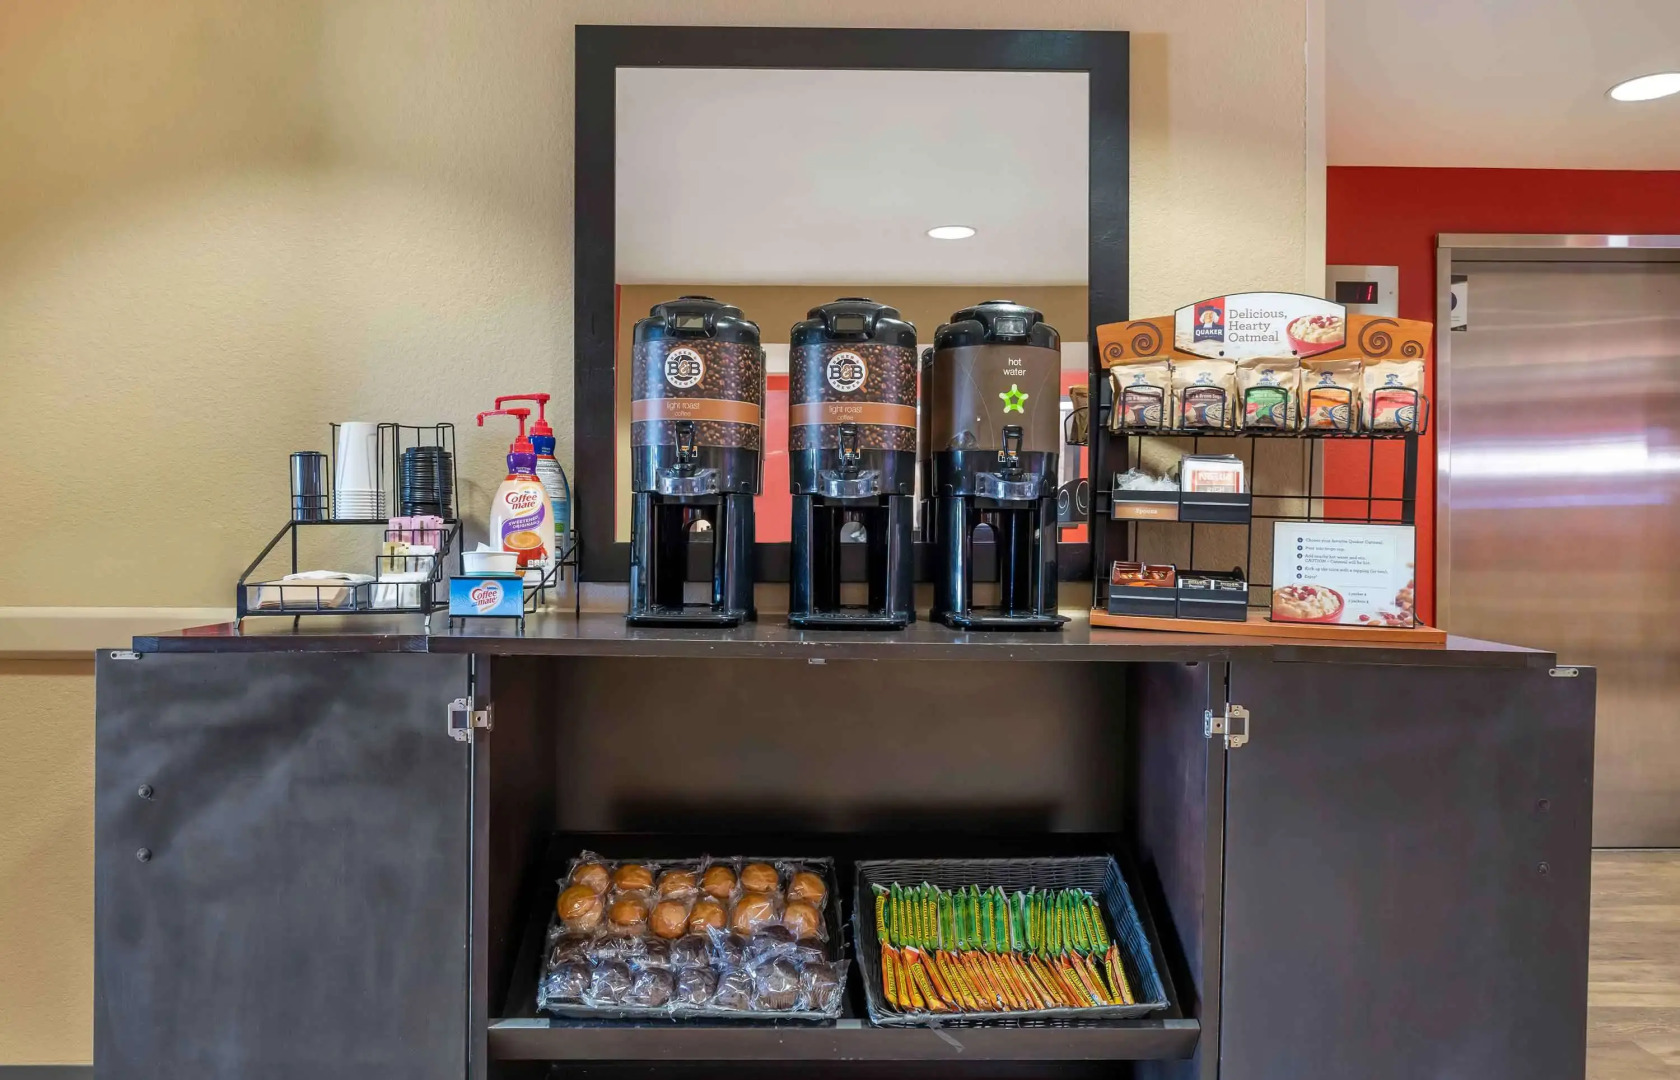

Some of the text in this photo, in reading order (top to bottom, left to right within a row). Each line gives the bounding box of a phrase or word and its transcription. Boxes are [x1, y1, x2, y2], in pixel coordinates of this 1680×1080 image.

[1368, 285, 1373, 300] 1
[1229, 308, 1287, 319] Delicious,
[1228, 320, 1270, 332] Hearty
[1195, 328, 1223, 336] QUAKER
[1228, 332, 1278, 342] Oatmeal
[1008, 357, 1022, 366] hot
[1003, 368, 1026, 376] water
[666, 402, 680, 411] light
[829, 405, 843, 414] light
[505, 492, 537, 504] Coffee
[512, 501, 535, 510] mate
[472, 589, 497, 600] Coffee
[478, 597, 496, 605] mate
